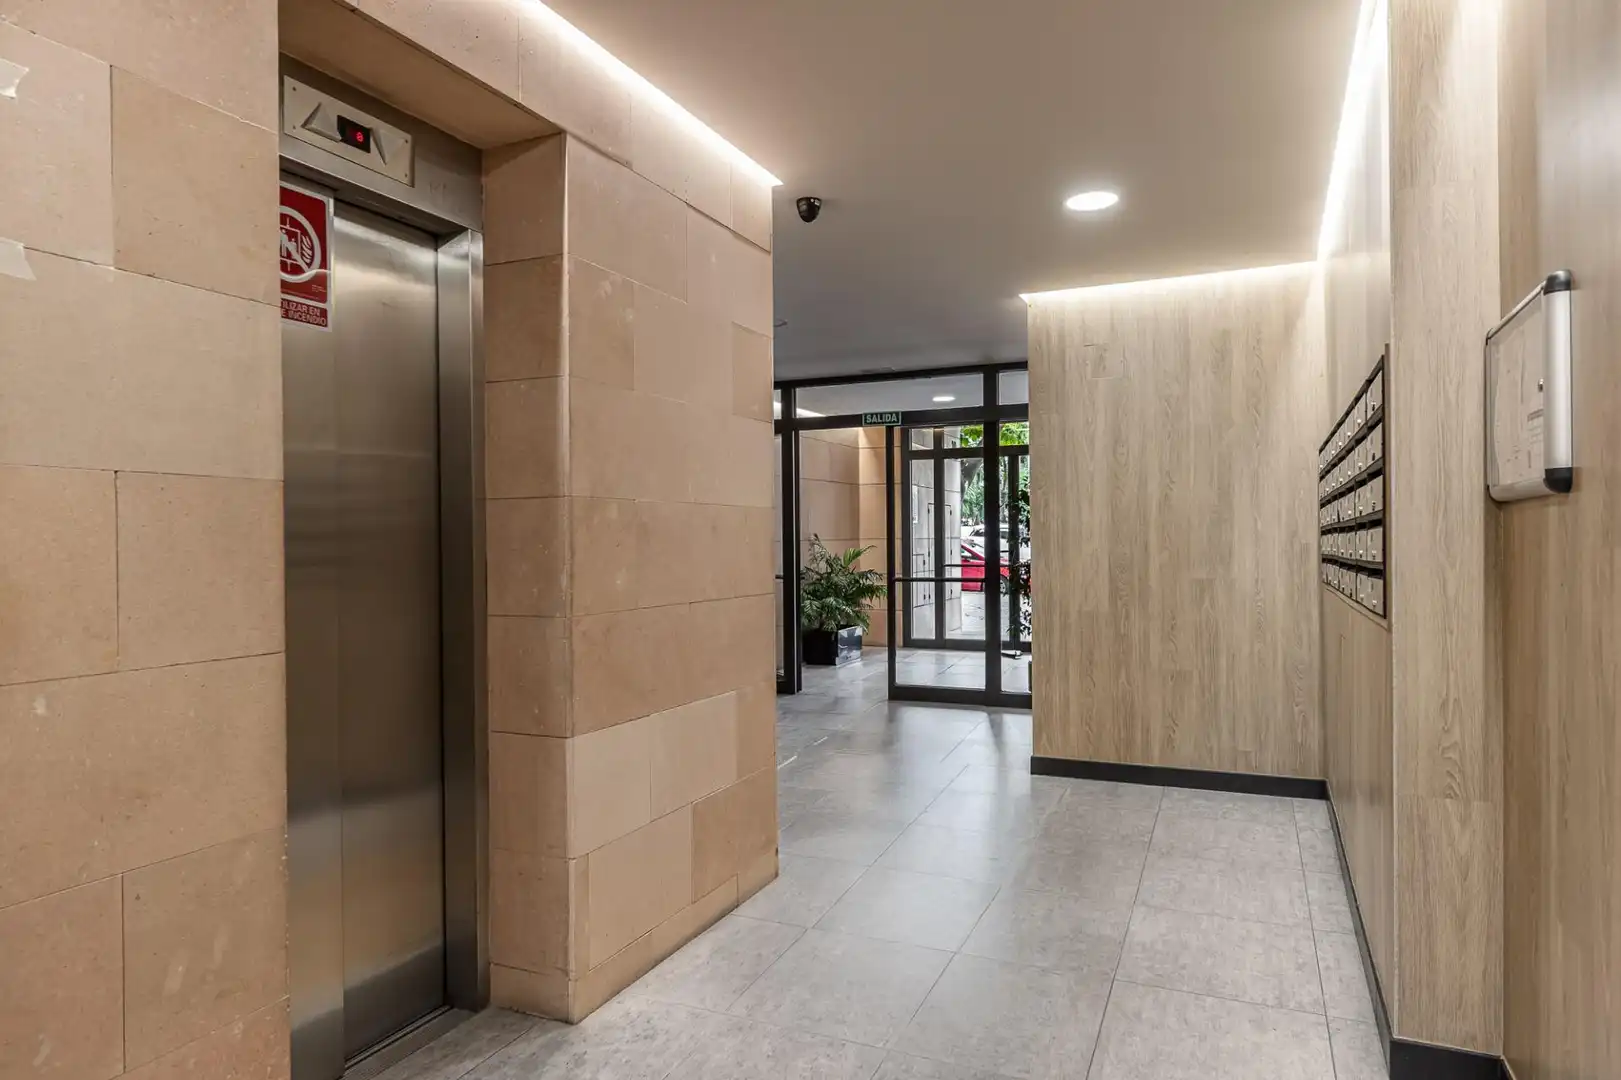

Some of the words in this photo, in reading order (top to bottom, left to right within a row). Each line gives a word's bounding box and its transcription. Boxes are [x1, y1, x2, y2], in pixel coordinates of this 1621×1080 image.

[281, 300, 308, 313] ILIZAR
[309, 306, 320, 316] EN
[288, 310, 326, 326] INCENDIO
[866, 413, 898, 423] SALIDA
